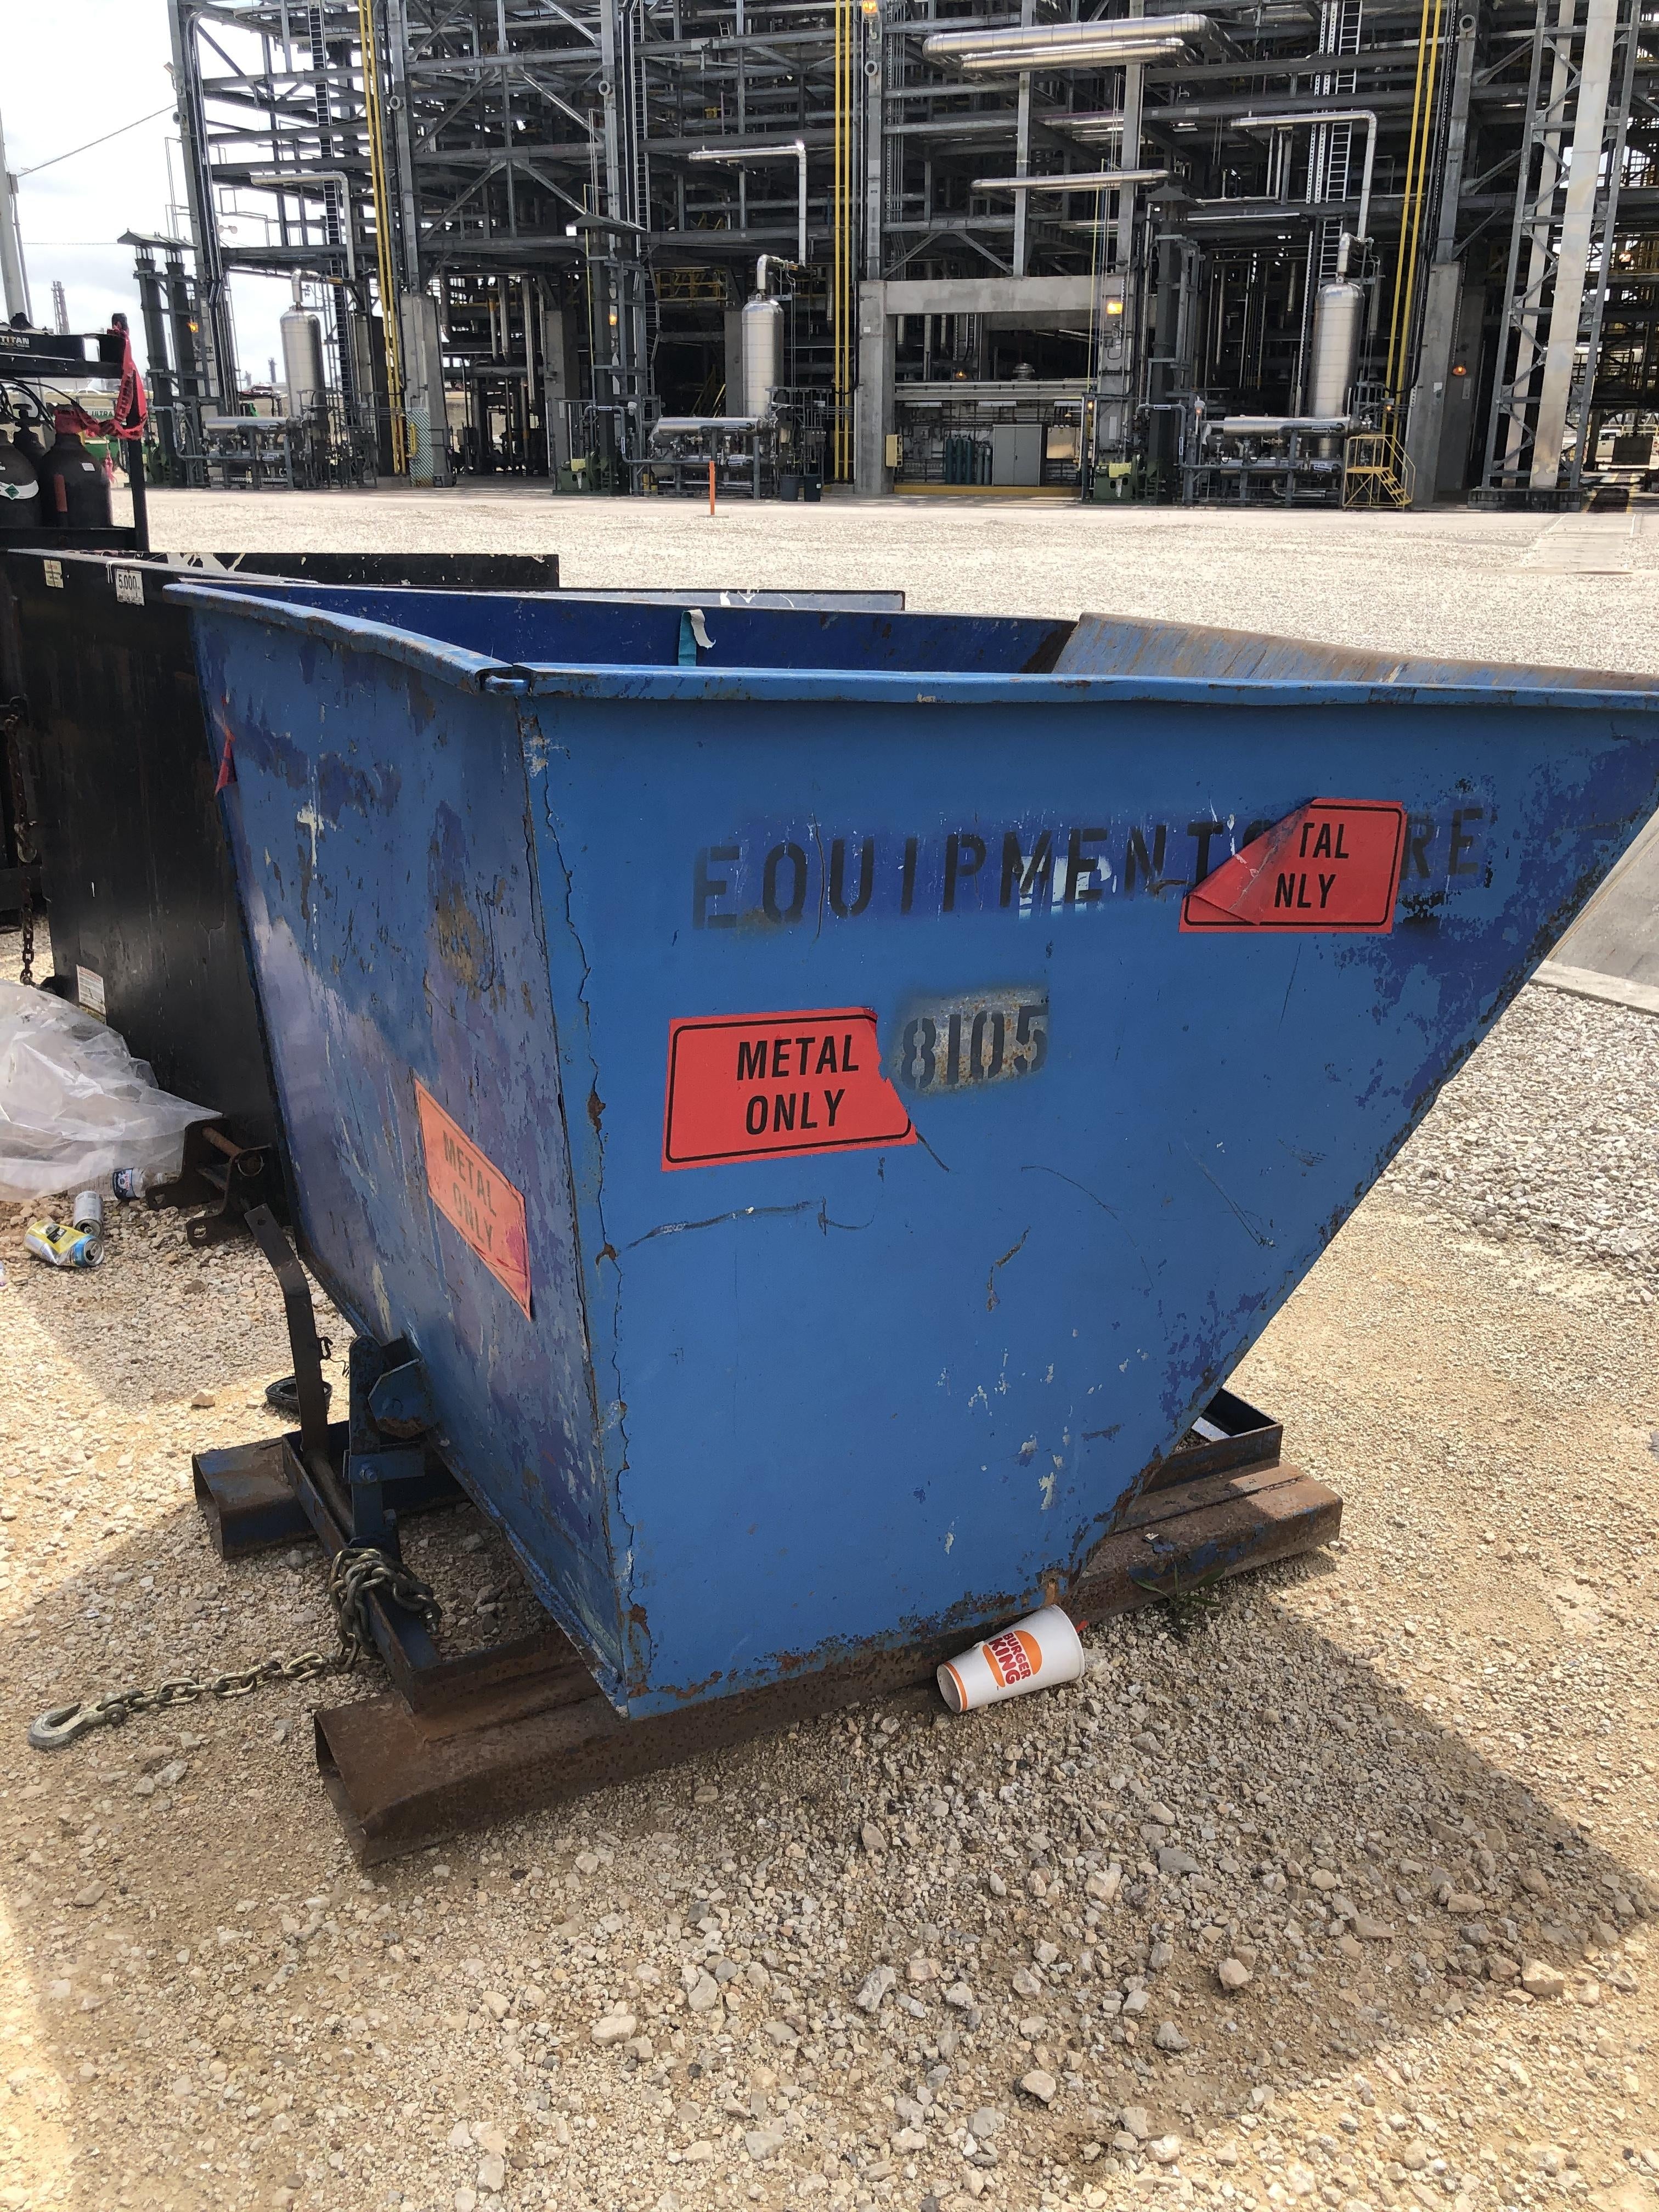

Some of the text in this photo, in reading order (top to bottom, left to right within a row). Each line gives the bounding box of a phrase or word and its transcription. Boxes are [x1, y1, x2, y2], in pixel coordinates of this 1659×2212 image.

[0, 335, 30, 345] TITAN
[1299, 822, 1350, 859] TAL
[1274, 873, 1336, 909] NLY
[737, 1035, 859, 1081] METAL
[901, 1006, 1048, 1090] 8105
[746, 1089, 845, 1135] ONLY
[443, 1130, 496, 1217] METAL
[453, 1182, 493, 1252] ONLY
[988, 1637, 1020, 1684] KING
[1003, 1632, 1031, 1679] BURGER
